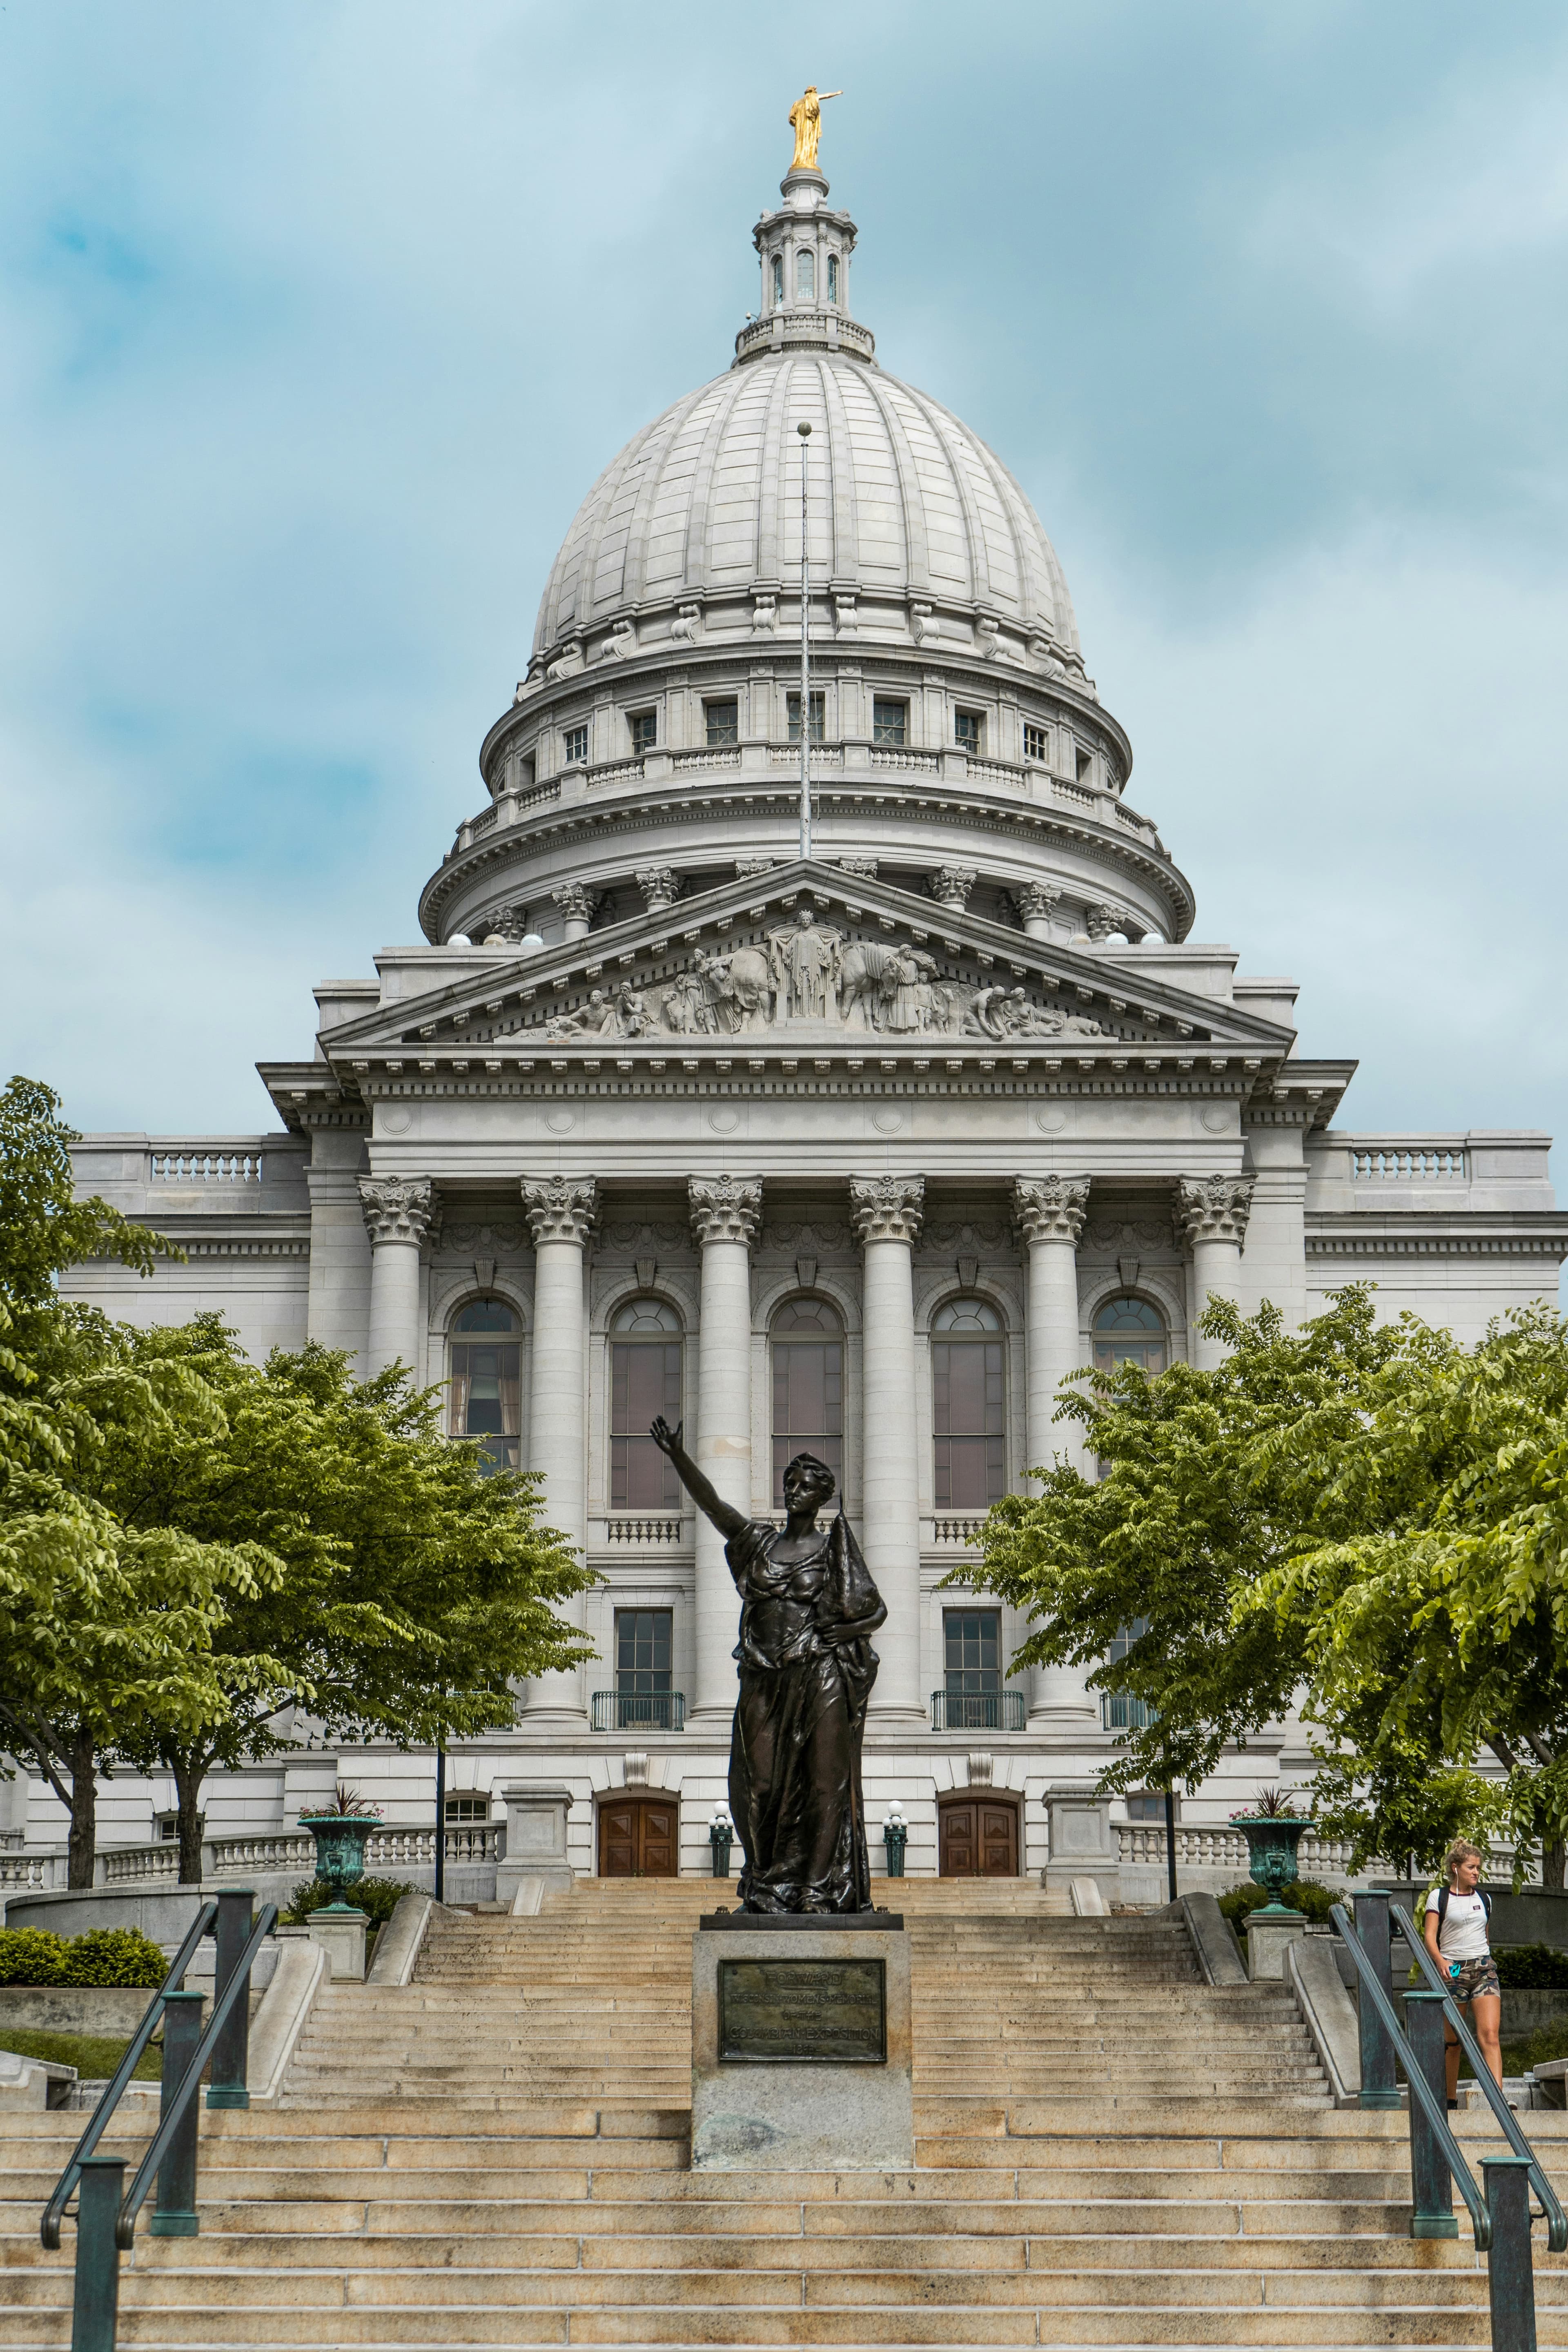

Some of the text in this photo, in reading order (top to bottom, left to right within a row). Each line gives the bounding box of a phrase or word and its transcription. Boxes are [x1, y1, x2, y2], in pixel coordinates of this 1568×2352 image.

[730, 1994, 780, 2003] WISCONSIN
[829, 1994, 878, 2004] MEMORIAL
[784, 2010, 821, 2021] OF THE
[730, 2026, 878, 2040] COLUMBIAN EXPOSITION
